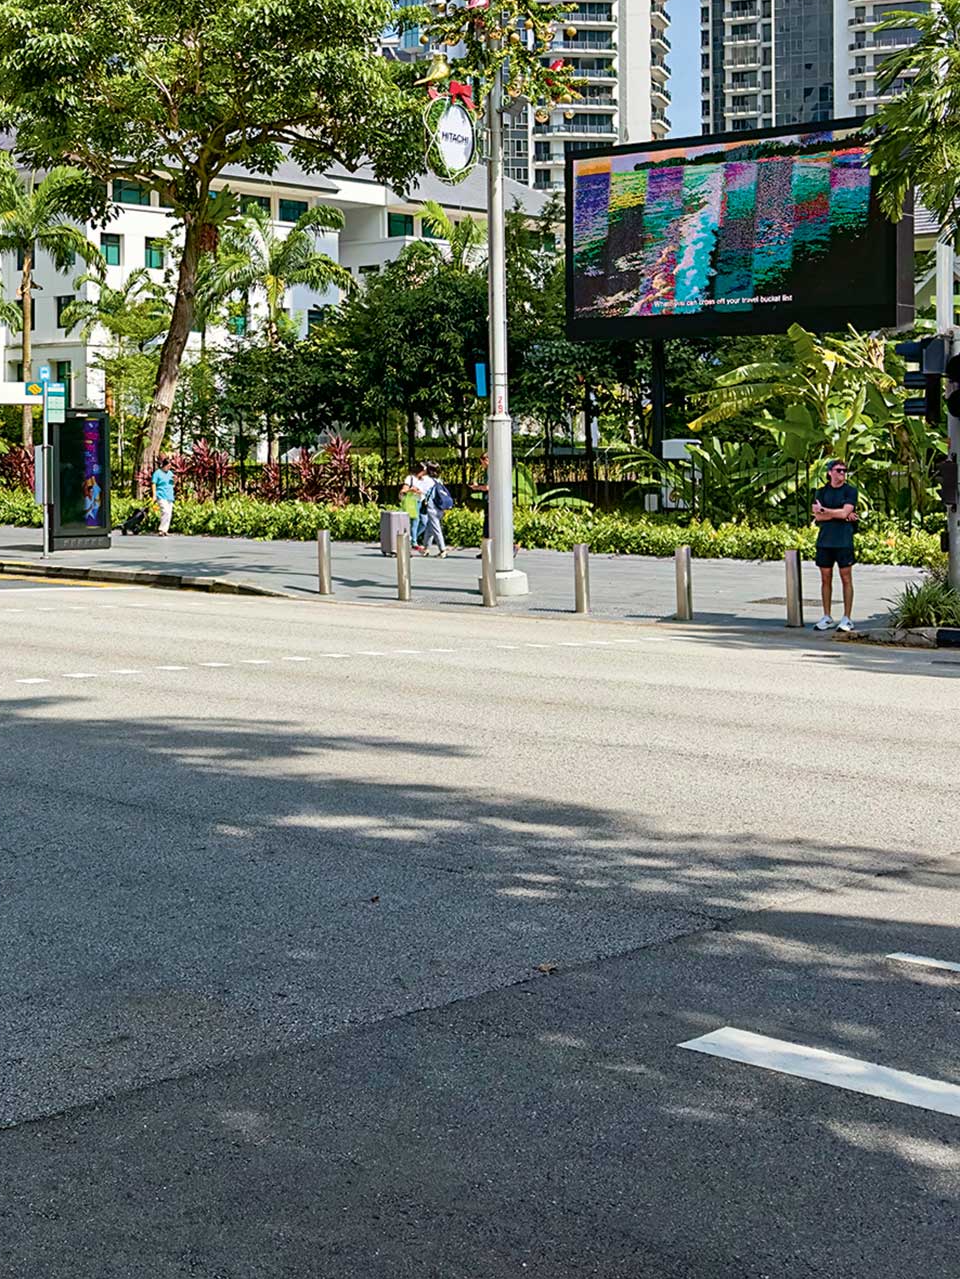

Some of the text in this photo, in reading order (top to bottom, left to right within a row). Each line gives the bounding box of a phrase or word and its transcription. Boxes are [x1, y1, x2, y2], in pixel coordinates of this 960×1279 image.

[442, 131, 469, 144] HITACHI
[716, 297, 726, 305] off
[726, 297, 740, 305] your
[741, 295, 759, 304] travel
[760, 295, 781, 303] bucket
